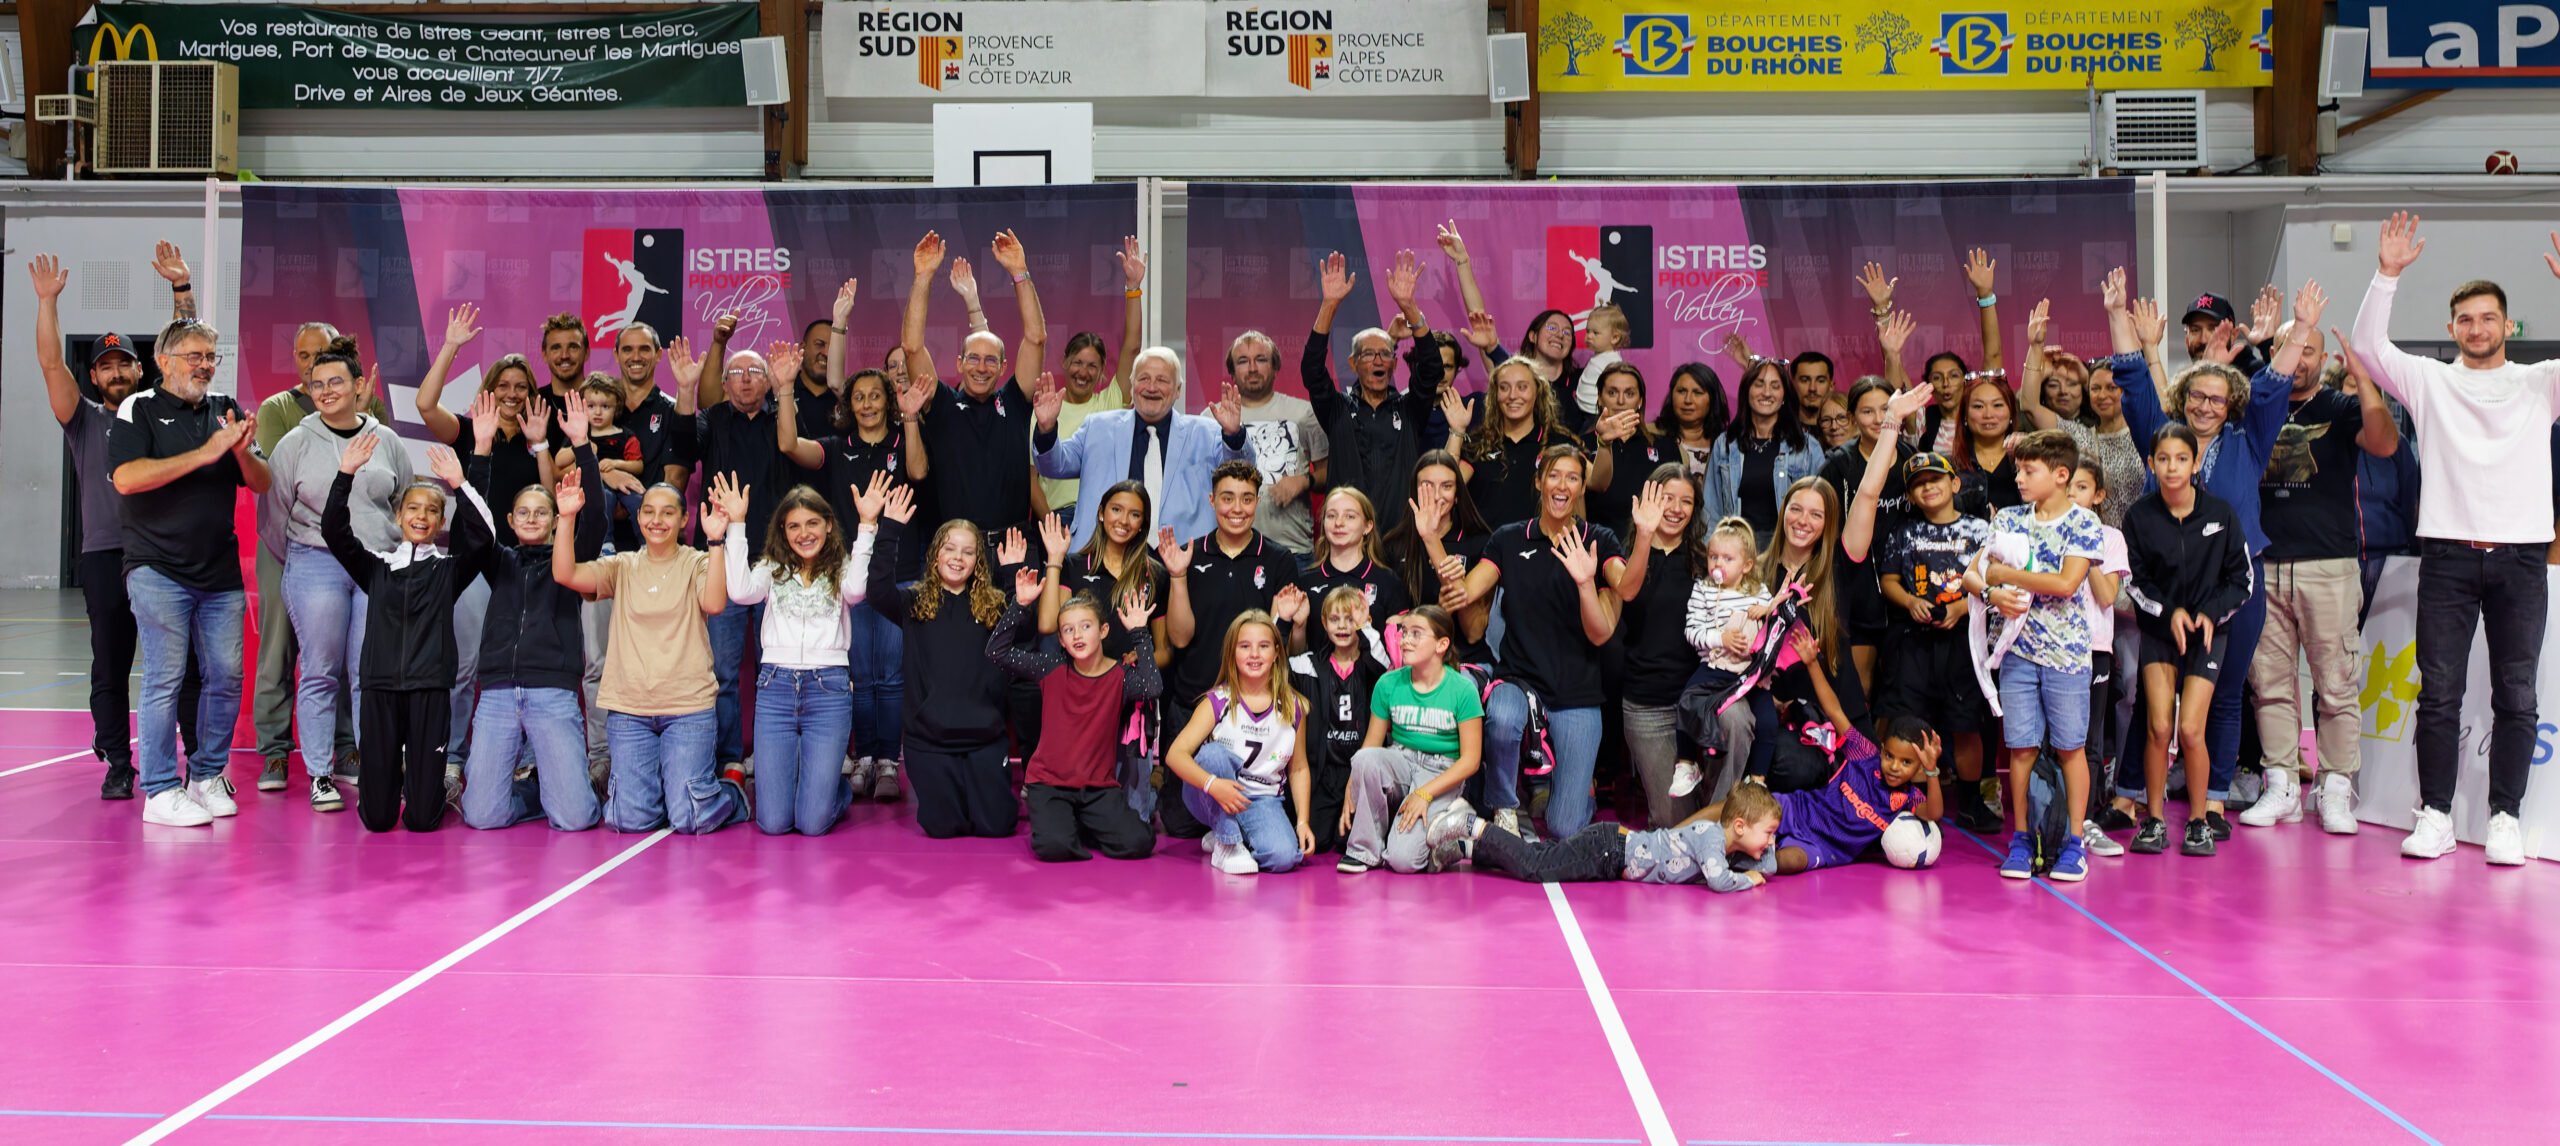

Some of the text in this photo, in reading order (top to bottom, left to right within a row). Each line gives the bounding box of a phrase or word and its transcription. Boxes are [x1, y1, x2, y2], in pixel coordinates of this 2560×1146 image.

[858, 7, 963, 32] RÉGION
[1226, 6, 1333, 31] RÉGION
[1706, 12, 1843, 28] DÉPARTEMENT
[2025, 10, 2163, 25] DÉPARTEMENT
[220, 18, 257, 36] Vos
[266, 21, 378, 39] restaurants
[386, 23, 412, 39] de
[420, 24, 472, 41] Istres
[620, 21, 699, 40] Leclerc,
[1338, 33, 1425, 47] PROVENCE
[2368, 6, 2481, 68] La
[179, 39, 740, 62] Martigues, Port de Bouc et Chateauneuf les Martigues
[859, 36, 916, 57] SUD
[968, 36, 1054, 49] PROVENCE
[1228, 35, 1286, 56] SUD
[1640, 25, 1678, 67] 13
[1958, 23, 1997, 65] 13
[968, 53, 1014, 67] ALPES
[1338, 51, 1385, 65] ALPES
[352, 67, 398, 80] vous
[407, 66, 515, 82] accueillent
[968, 68, 1072, 85] CÔTE D'AZUR
[1338, 66, 1444, 83] CÔTE D'AZUR
[294, 84, 622, 102] Drive et Aires de Jeux Géantes.
[689, 248, 792, 272] ISTRES
[1658, 245, 1767, 270] ISTRES
[689, 272, 793, 289] PROVENCE
[1658, 271, 1769, 288] PROVENCE
[1339, 694, 1352, 721] 2
[1243, 739, 1264, 770] 7
